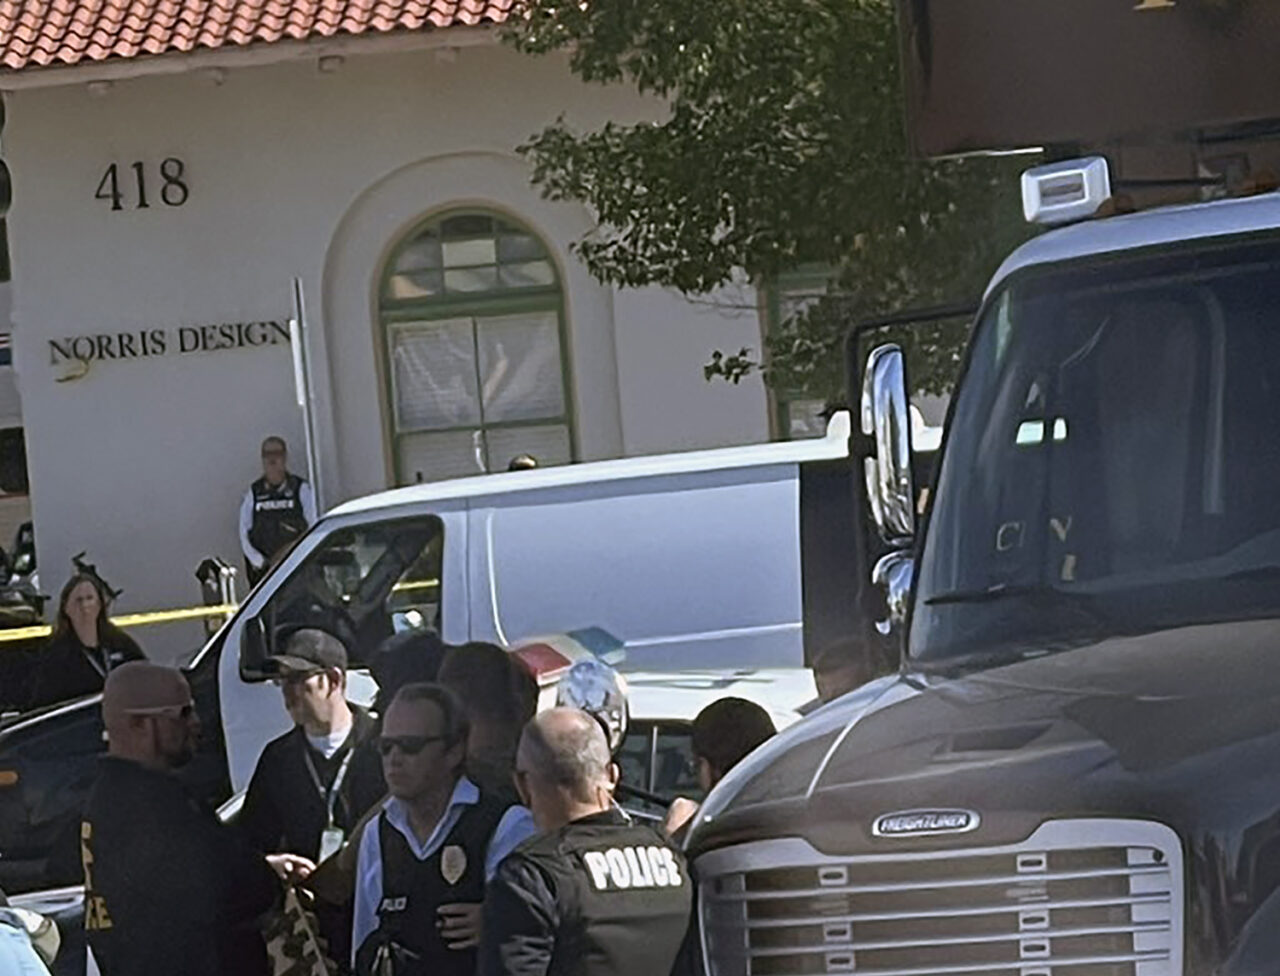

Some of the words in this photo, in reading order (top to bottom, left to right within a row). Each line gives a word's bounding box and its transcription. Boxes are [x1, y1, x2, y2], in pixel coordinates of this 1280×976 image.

[94, 157, 189, 211] 418
[48, 329, 166, 364] NORRIS
[178, 319, 292, 353] DESIGN
[584, 846, 682, 890] POLICE
